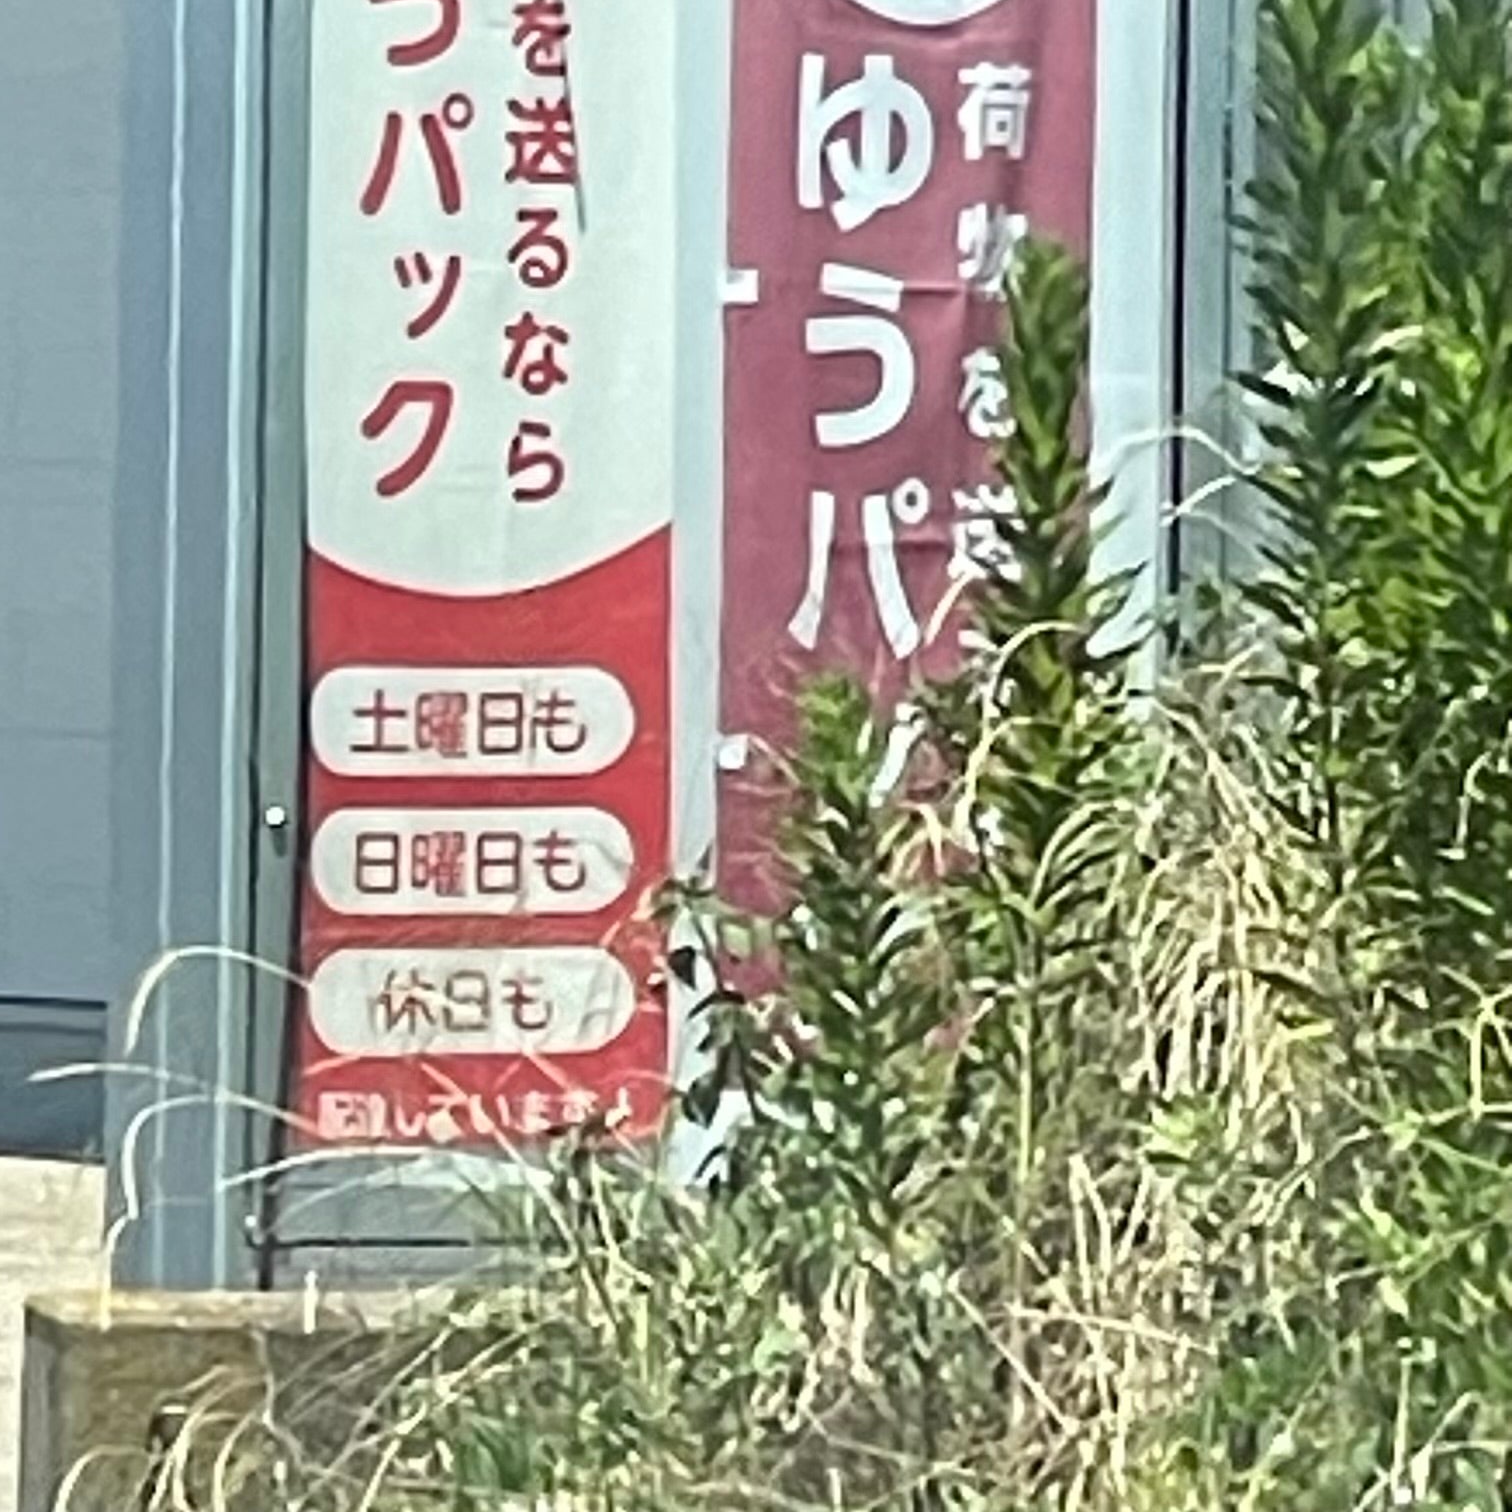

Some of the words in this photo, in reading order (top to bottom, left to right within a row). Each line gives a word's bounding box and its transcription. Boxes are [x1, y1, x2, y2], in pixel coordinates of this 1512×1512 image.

[349, 689, 587, 758] 土曜日も
[355, 830, 587, 897] 日曜日も
[374, 968, 552, 1032] 休日も
